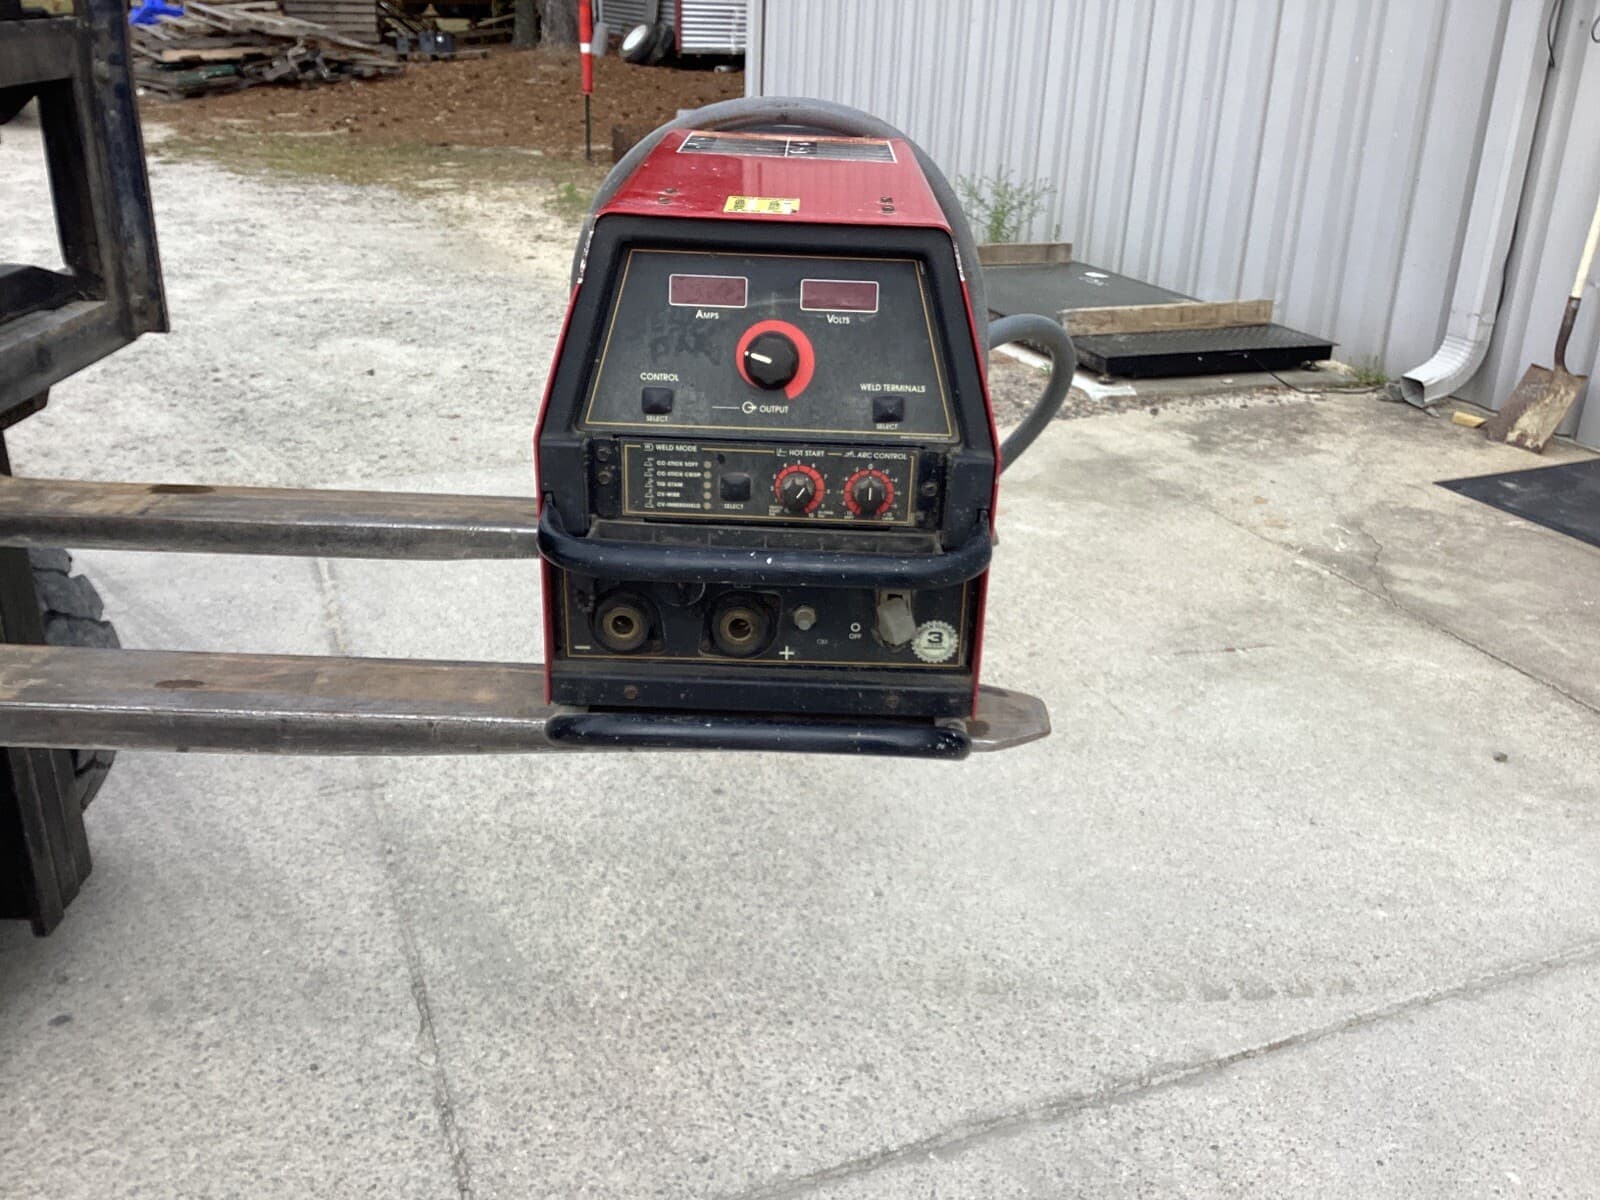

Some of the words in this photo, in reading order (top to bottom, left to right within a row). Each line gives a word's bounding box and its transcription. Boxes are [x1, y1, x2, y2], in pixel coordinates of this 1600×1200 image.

[695, 309, 720, 320] AMPS
[826, 314, 851, 325] VOLTS
[639, 372, 680, 382] CONTROL
[859, 383, 882, 392] WELD
[883, 383, 926, 393] TERMINALS
[759, 405, 790, 414] OUTPUT
[645, 415, 669, 423] SELECT
[656, 443, 674, 451] WELD
[675, 444, 697, 452] MODE
[805, 450, 825, 458] START
[857, 451, 873, 459] ARC
[873, 452, 908, 461] CONTROL
[928, 631, 943, 644] 3
